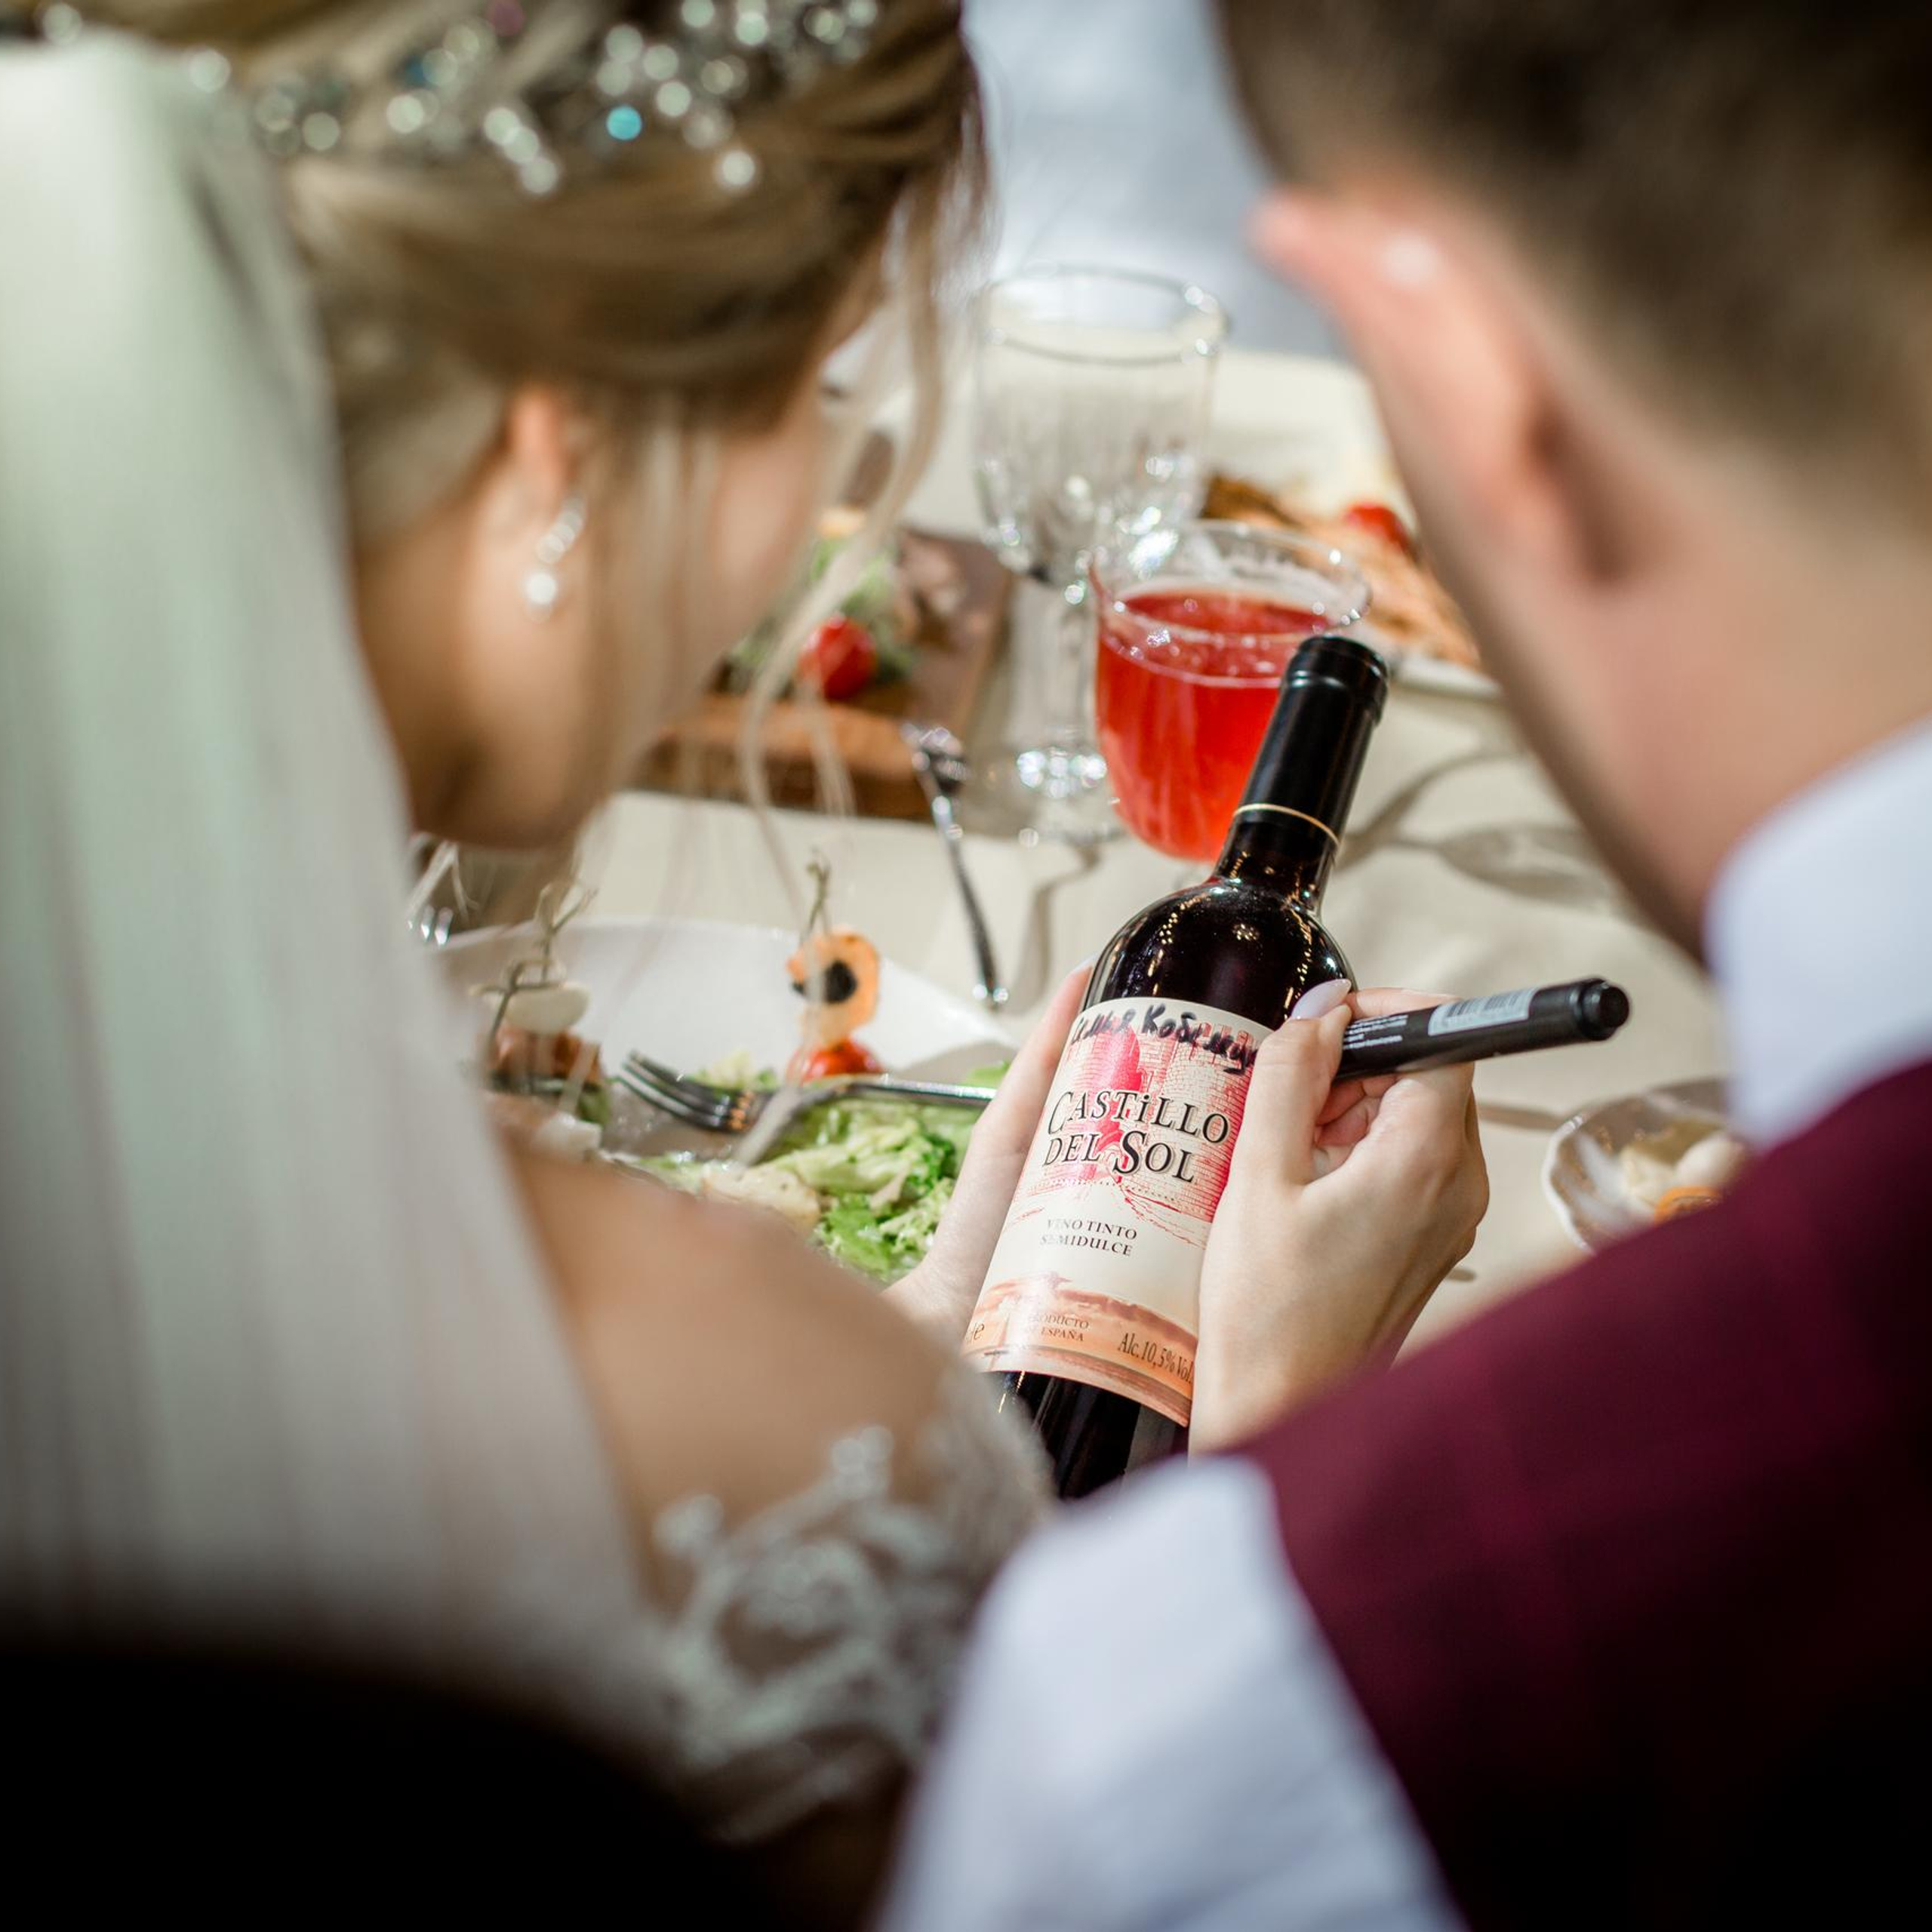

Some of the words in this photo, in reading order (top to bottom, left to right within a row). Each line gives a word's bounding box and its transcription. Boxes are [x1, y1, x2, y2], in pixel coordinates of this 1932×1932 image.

[1042, 1133, 1101, 1167] DEL
[1112, 1131, 1195, 1183] SOL
[1047, 1218, 1084, 1231] VNO
[1086, 1220, 1137, 1241] TINTO
[1030, 1312, 1090, 1331] ODUCTO
[1117, 1332, 1140, 1358] Alc.
